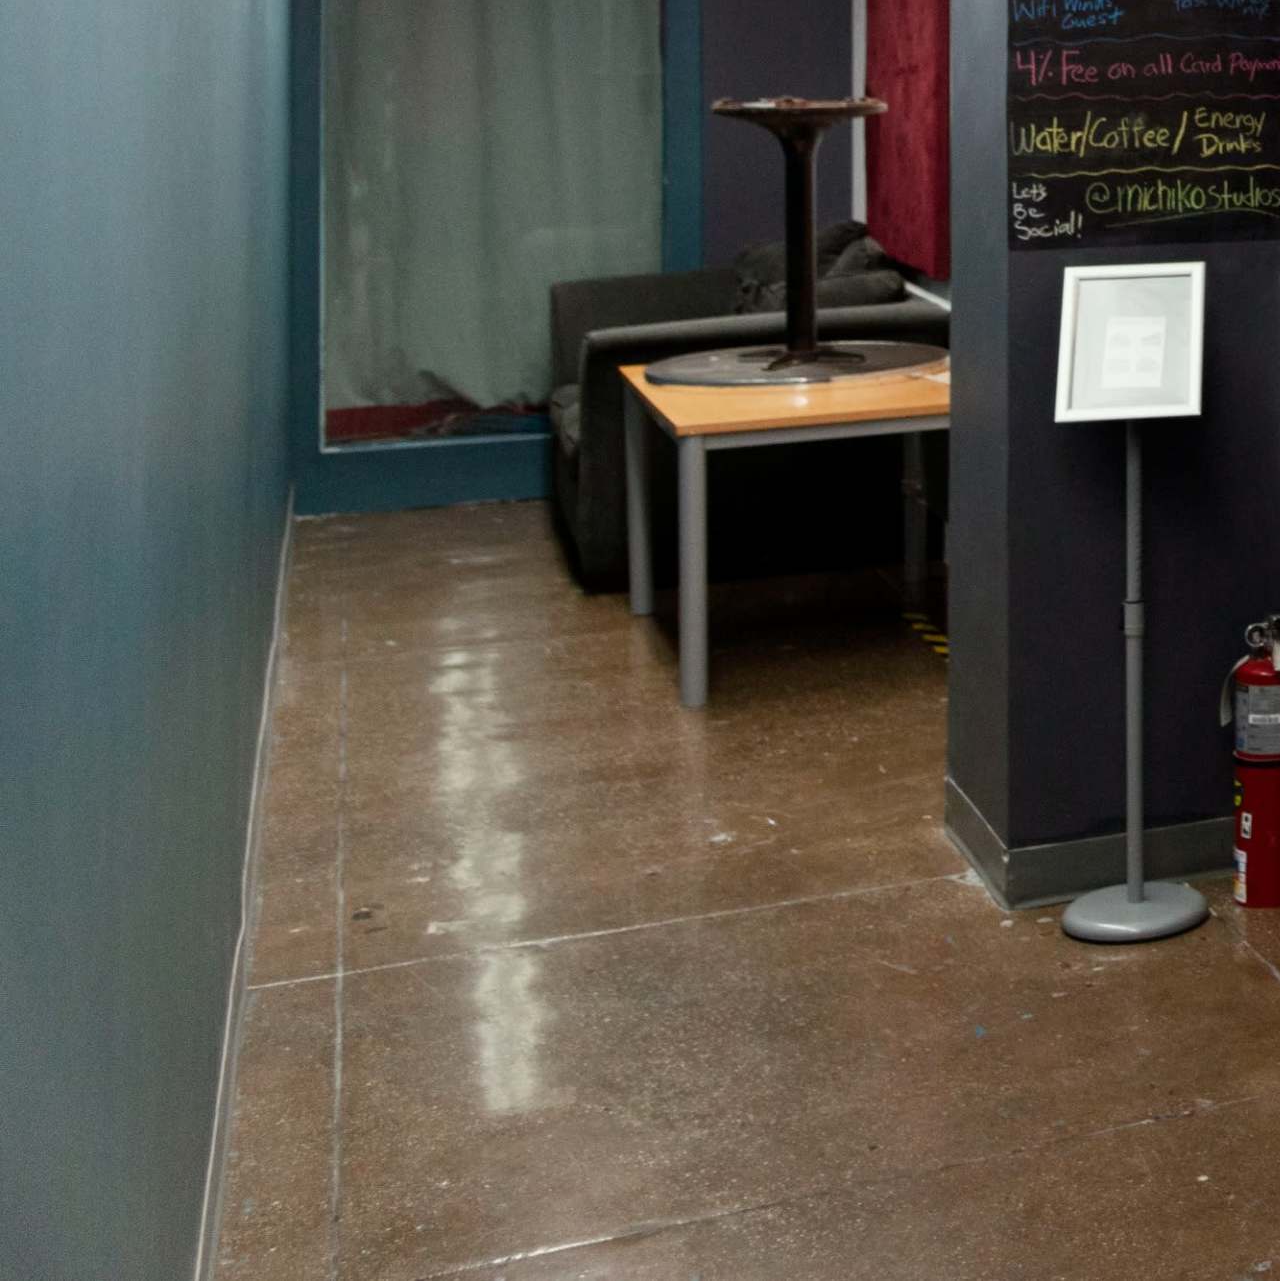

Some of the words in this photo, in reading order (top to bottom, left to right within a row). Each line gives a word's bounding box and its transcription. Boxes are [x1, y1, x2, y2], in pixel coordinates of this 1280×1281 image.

[1060, 49, 1099, 85] Fee
[1107, 62, 1136, 80] on
[1143, 53, 1173, 77] all
[1179, 52, 1222, 74] Card
[1194, 132, 1262, 158] Drinks
[1013, 203, 1045, 219] Be
